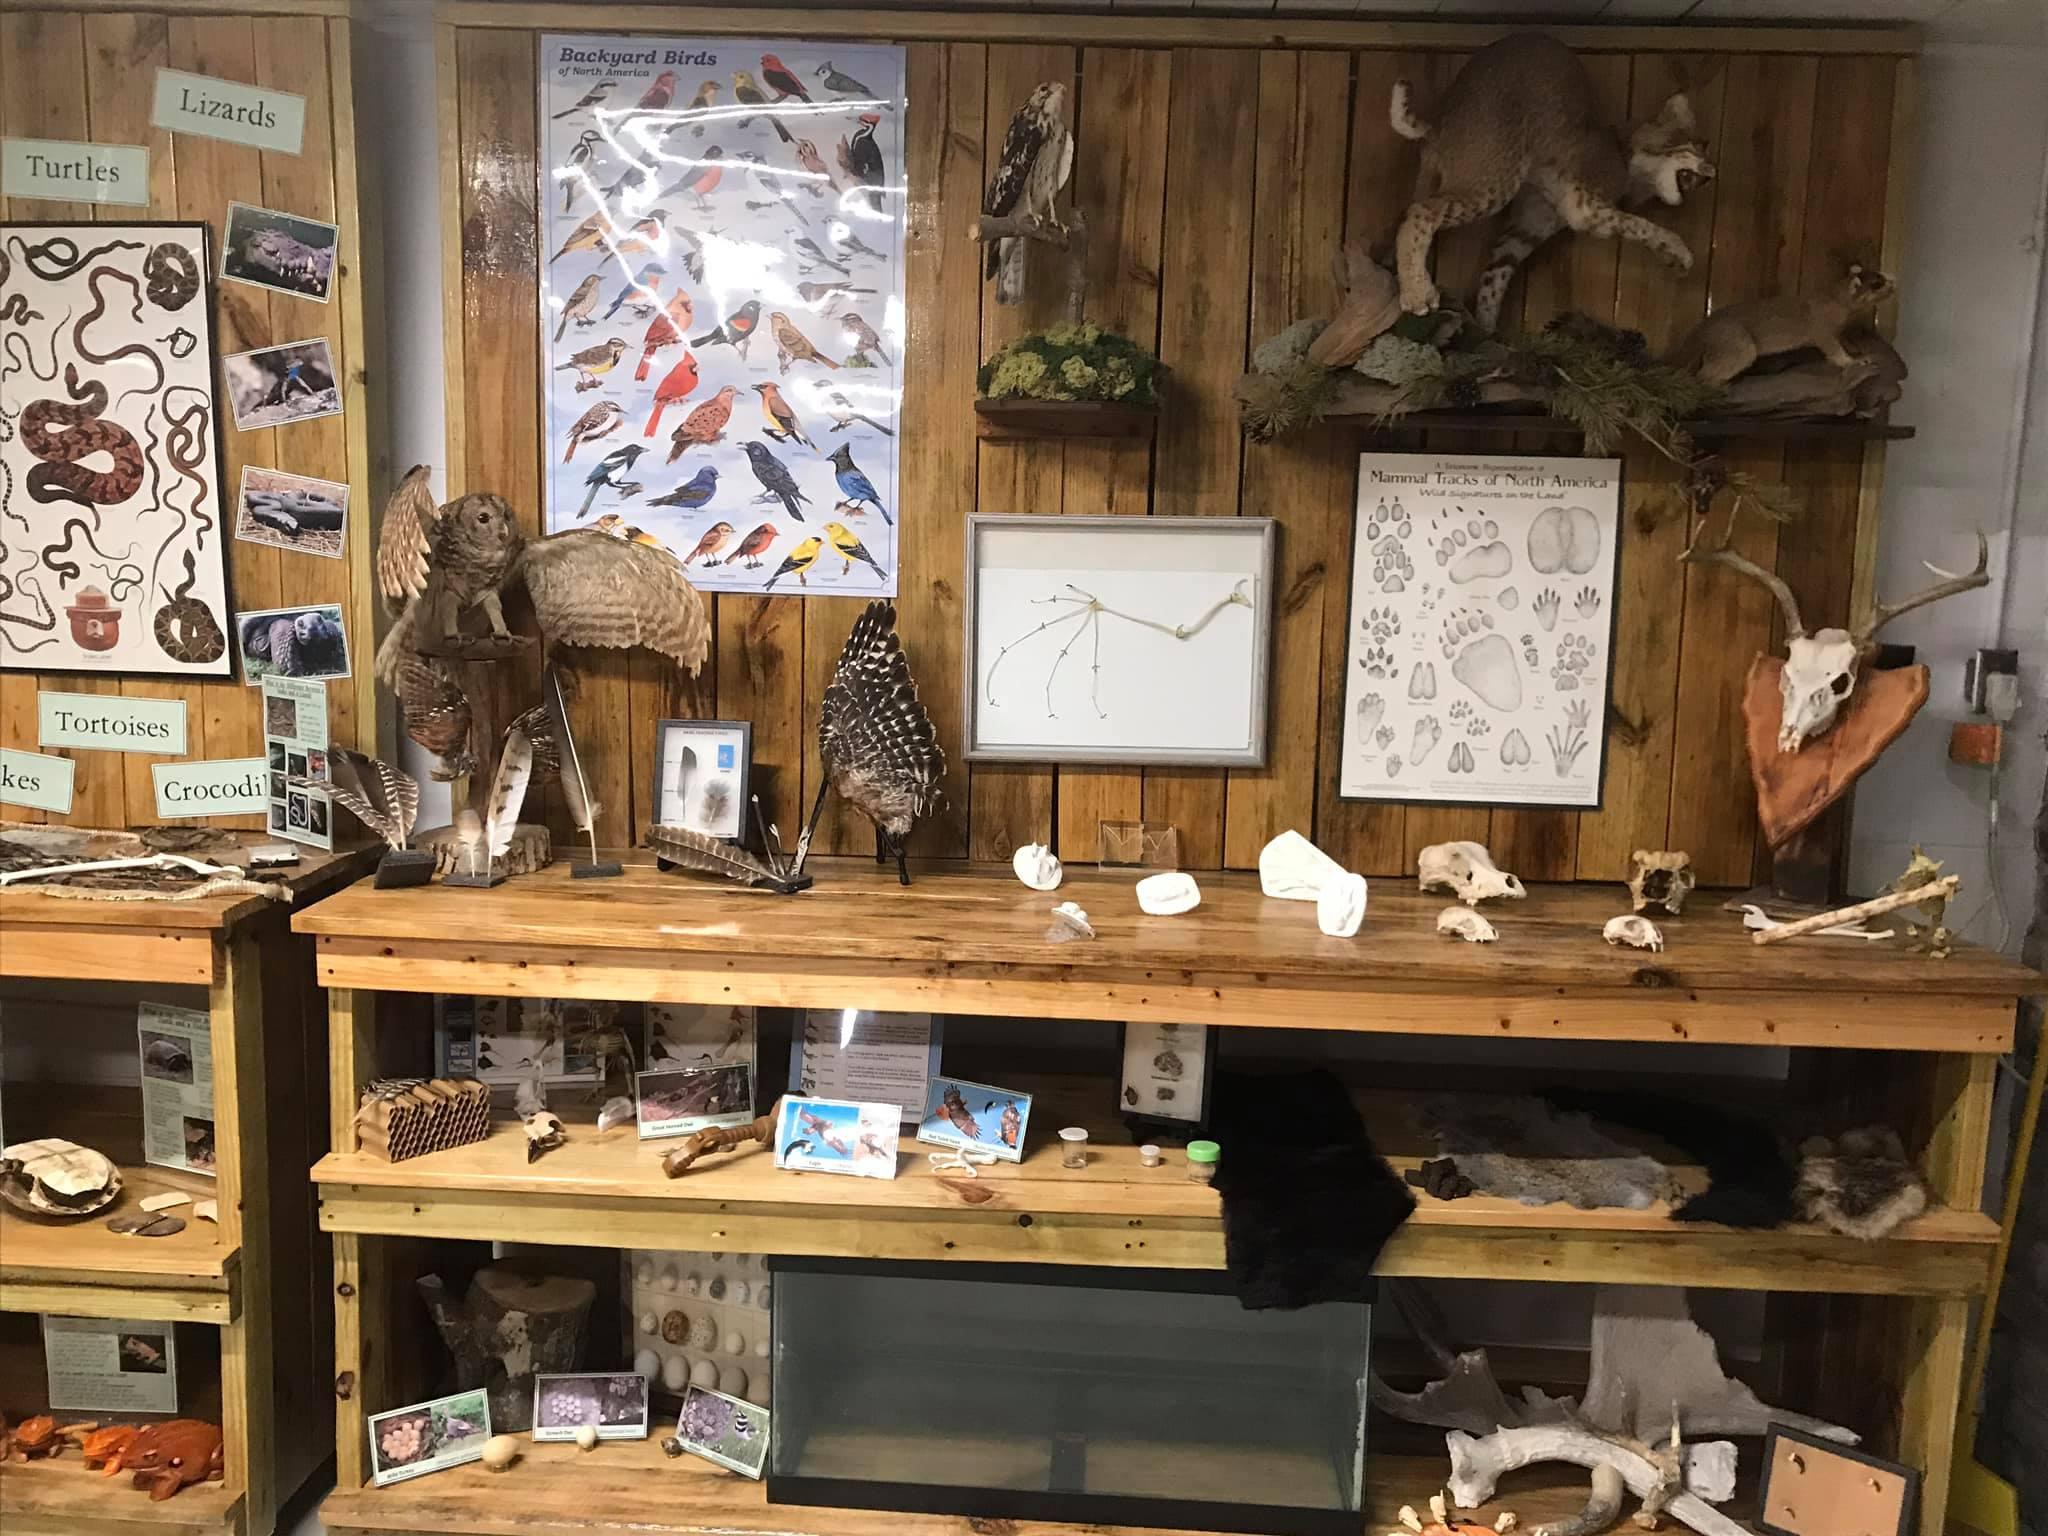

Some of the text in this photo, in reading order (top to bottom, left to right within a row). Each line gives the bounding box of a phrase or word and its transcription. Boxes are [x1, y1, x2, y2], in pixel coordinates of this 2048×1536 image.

[559, 47, 717, 67] Backyard Birds
[558, 66, 650, 77] of North America
[179, 88, 276, 128] Lizards
[26, 155, 120, 183] Turtles
[1371, 470, 1608, 489] Mammal Tracks of North America
[55, 711, 170, 738] Tortoises
